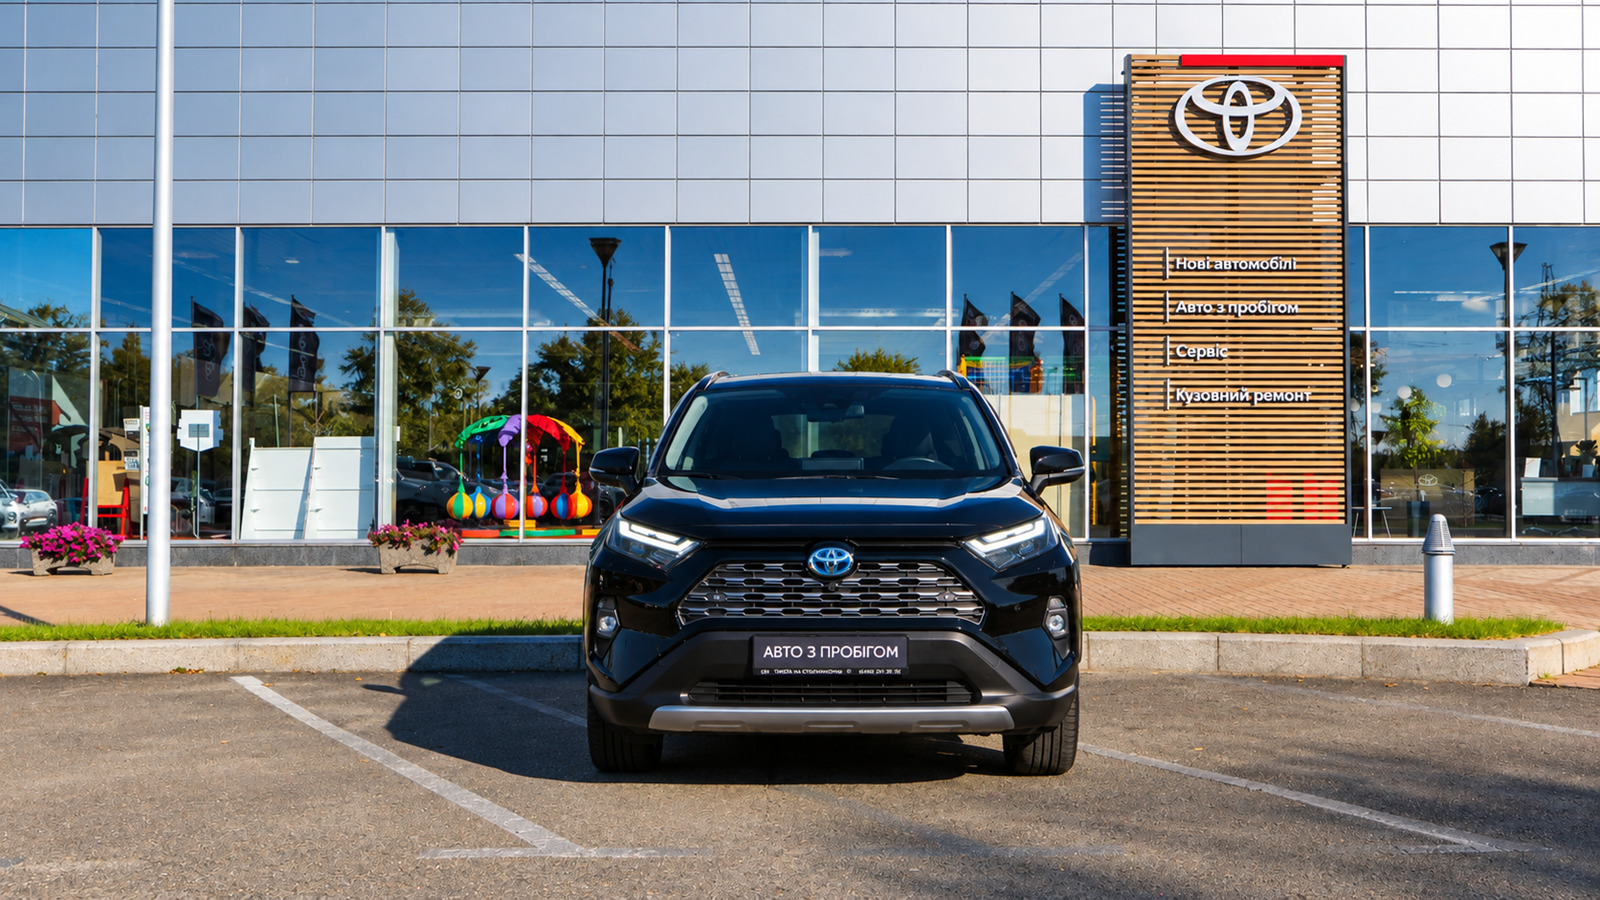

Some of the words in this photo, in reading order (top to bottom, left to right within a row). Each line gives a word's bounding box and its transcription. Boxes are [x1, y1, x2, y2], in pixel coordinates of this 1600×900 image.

[1175, 256, 1211, 270] Нові
[1214, 256, 1297, 270] автомобілі
[1175, 301, 1213, 313] Авто
[1216, 303, 1225, 313] з
[1228, 300, 1299, 317] пробігом
[1175, 344, 1229, 361] Сервіс
[1175, 387, 1250, 405] Кузовний
[1253, 391, 1312, 405] ремонт
[763, 645, 803, 658] АВТО
[807, 645, 816, 658] З
[820, 645, 899, 658] ПРОБІГОМ
